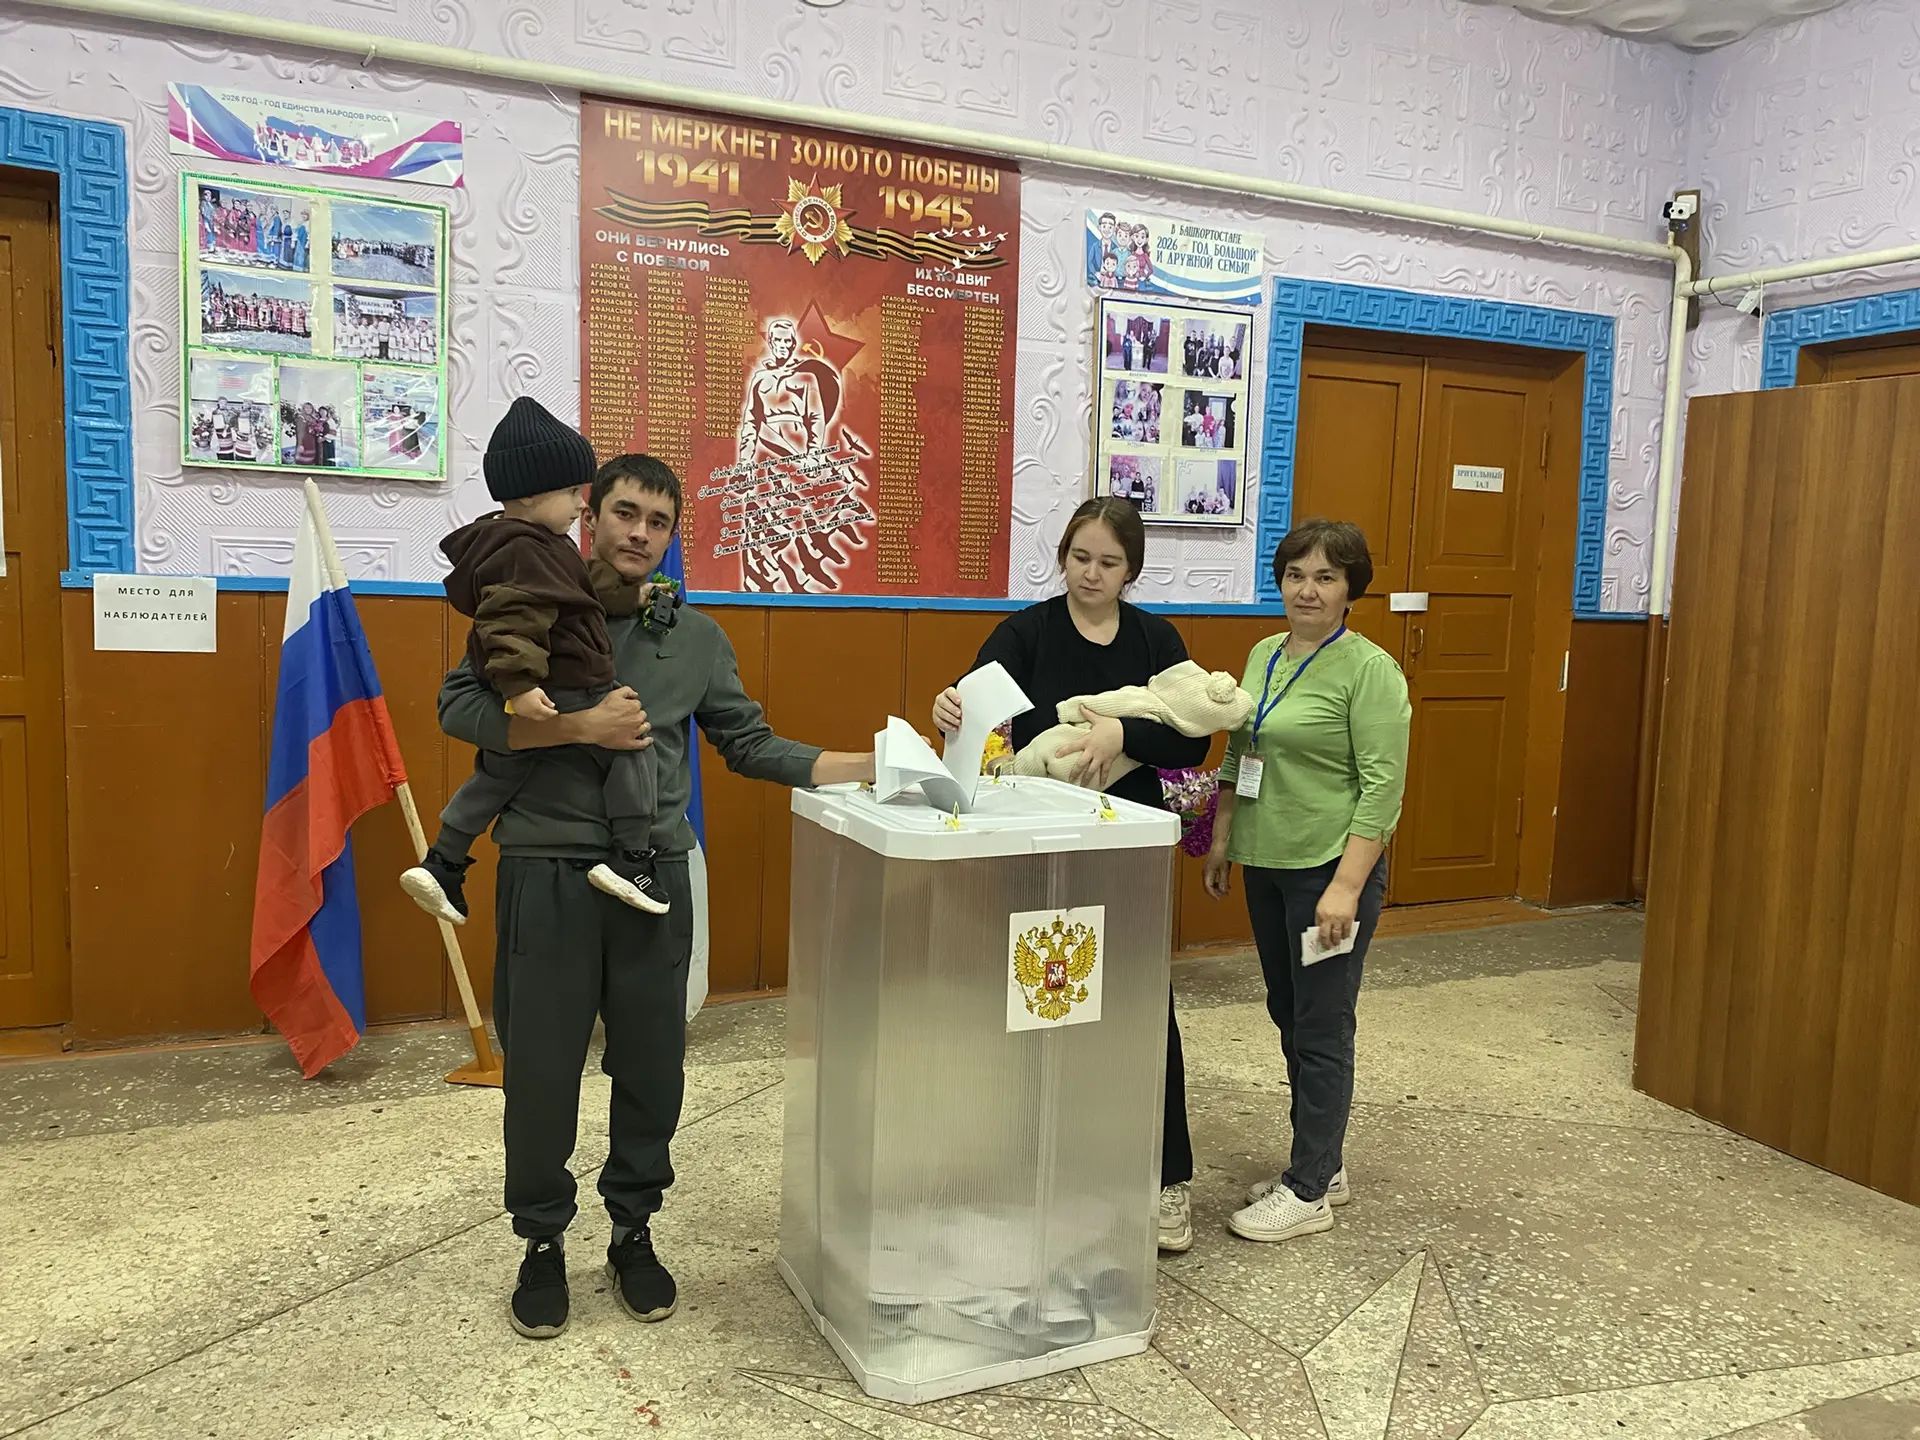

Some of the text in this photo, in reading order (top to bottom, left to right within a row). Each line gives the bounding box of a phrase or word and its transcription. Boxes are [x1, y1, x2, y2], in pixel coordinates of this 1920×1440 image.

[241, 96, 258, 105] ГОД
[264, 99, 281, 109] ГОД
[282, 102, 325, 115] ЕДИНСТВА
[326, 108, 364, 120] НАРОДОВ
[366, 114, 399, 123] РОСС
[605, 108, 999, 195] НЕ МЕРКНЕТ ЗОЛОТО ПОБЕДЫ
[636, 149, 740, 196] 1941
[878, 185, 973, 229] 1945
[595, 230, 730, 257] ОНИ ВЕРНУЛИСЬ
[1170, 224, 1242, 244] В БАШКОРТОСТАНЕ
[616, 250, 711, 272] С ПОБЕДОЙ
[1156, 236, 1257, 262] 2026 ГОД БОЛЬШОЙ
[1156, 250, 1250, 274] И ДРУЖНОЙ СЕМЬИ!
[915, 268, 933, 281] ИХ
[907, 283, 1000, 305] БЕССМЕРТЕН
[118, 587, 194, 598] МЕСТО ДЛЯ
[104, 611, 208, 621] НАБЛЮДАТЕЛЕЙ
